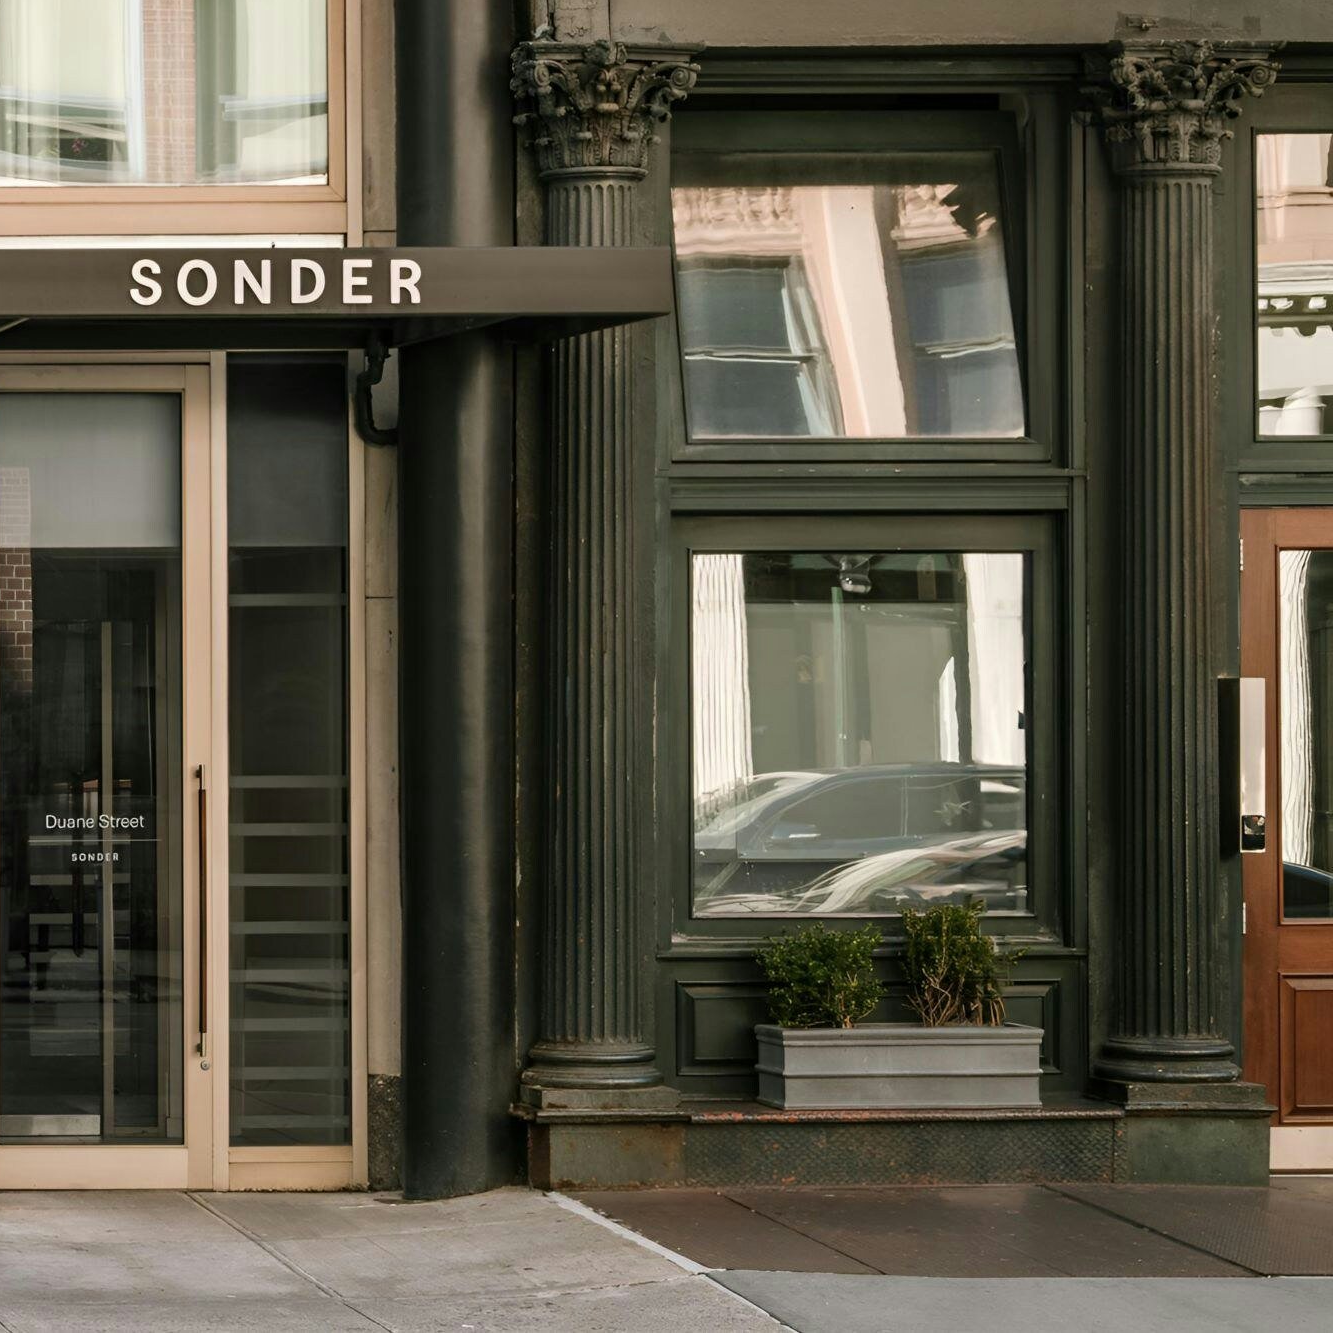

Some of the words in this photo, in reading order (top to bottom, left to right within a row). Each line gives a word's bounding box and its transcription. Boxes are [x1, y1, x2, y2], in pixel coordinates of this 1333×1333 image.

[129, 259, 422, 306] SONDER
[45, 814, 95, 829] Duane
[98, 814, 145, 829] Street
[71, 852, 119, 862] SONDER
